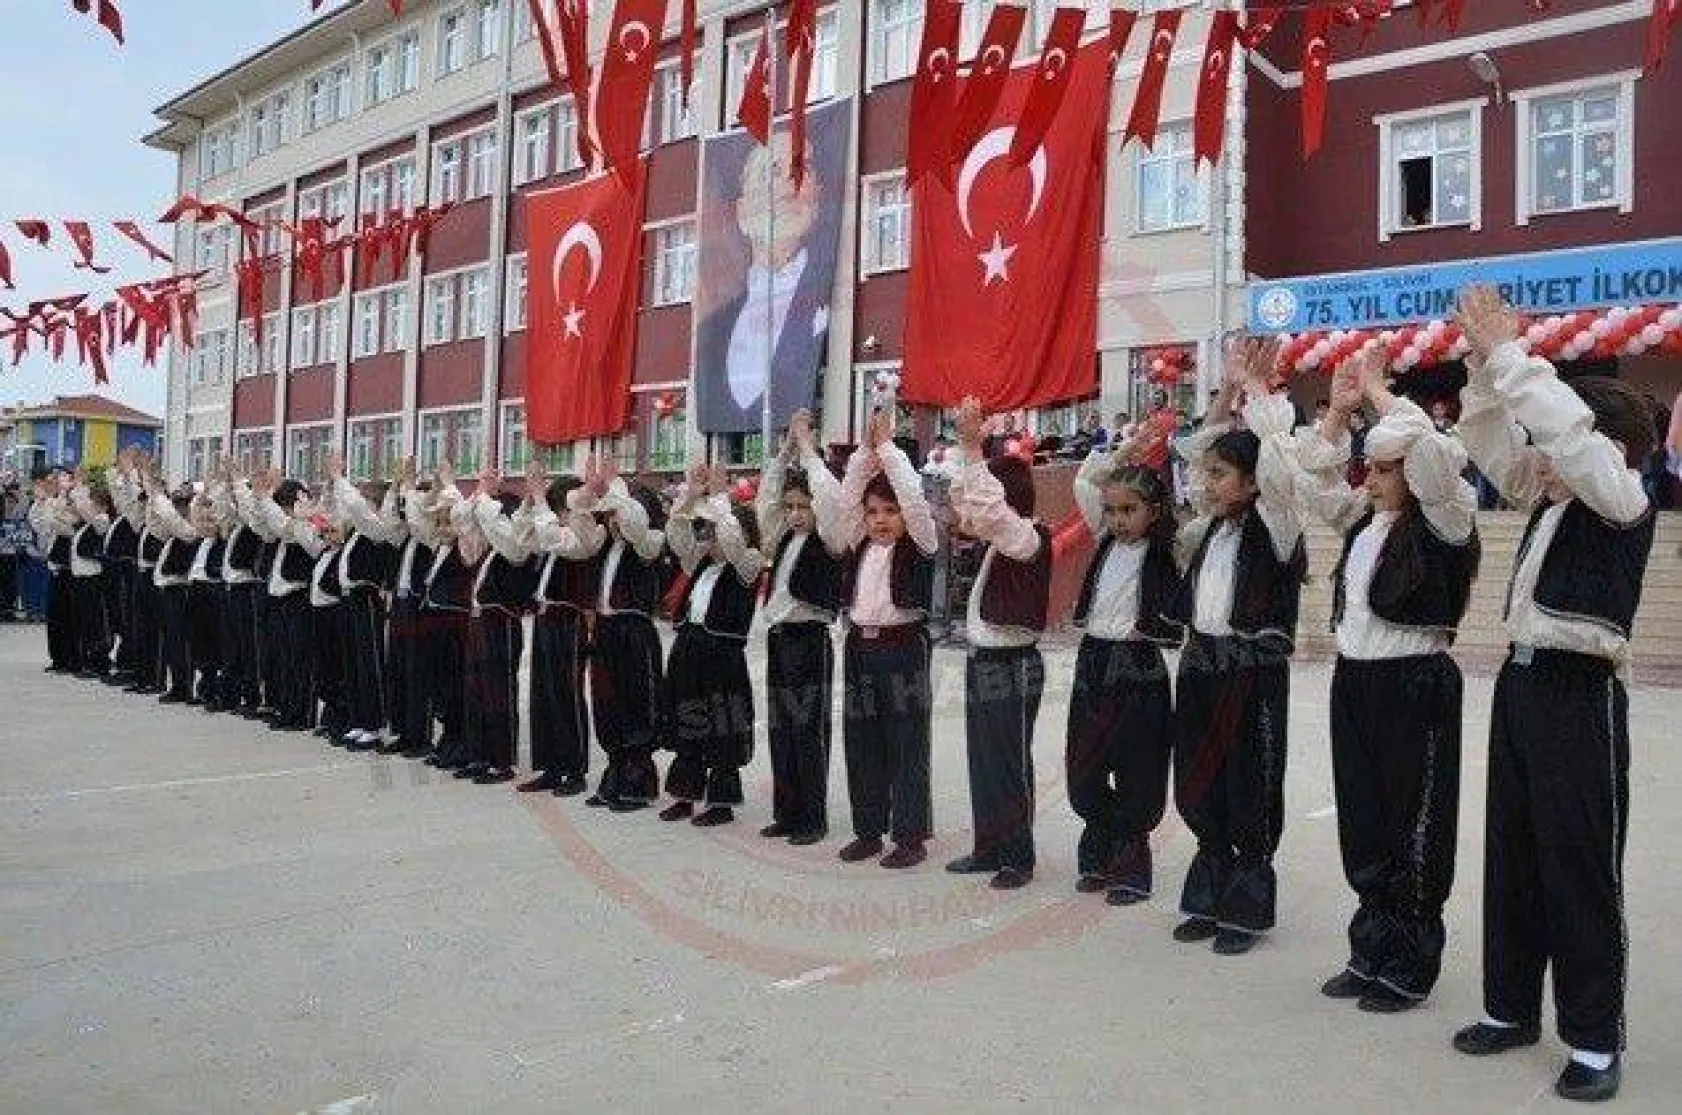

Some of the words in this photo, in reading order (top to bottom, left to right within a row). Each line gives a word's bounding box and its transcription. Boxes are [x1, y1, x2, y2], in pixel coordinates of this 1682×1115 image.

[1305, 298, 1341, 324] 75.
[1348, 293, 1389, 321] YIL
[1396, 274, 1582, 318] CUMRİYET
